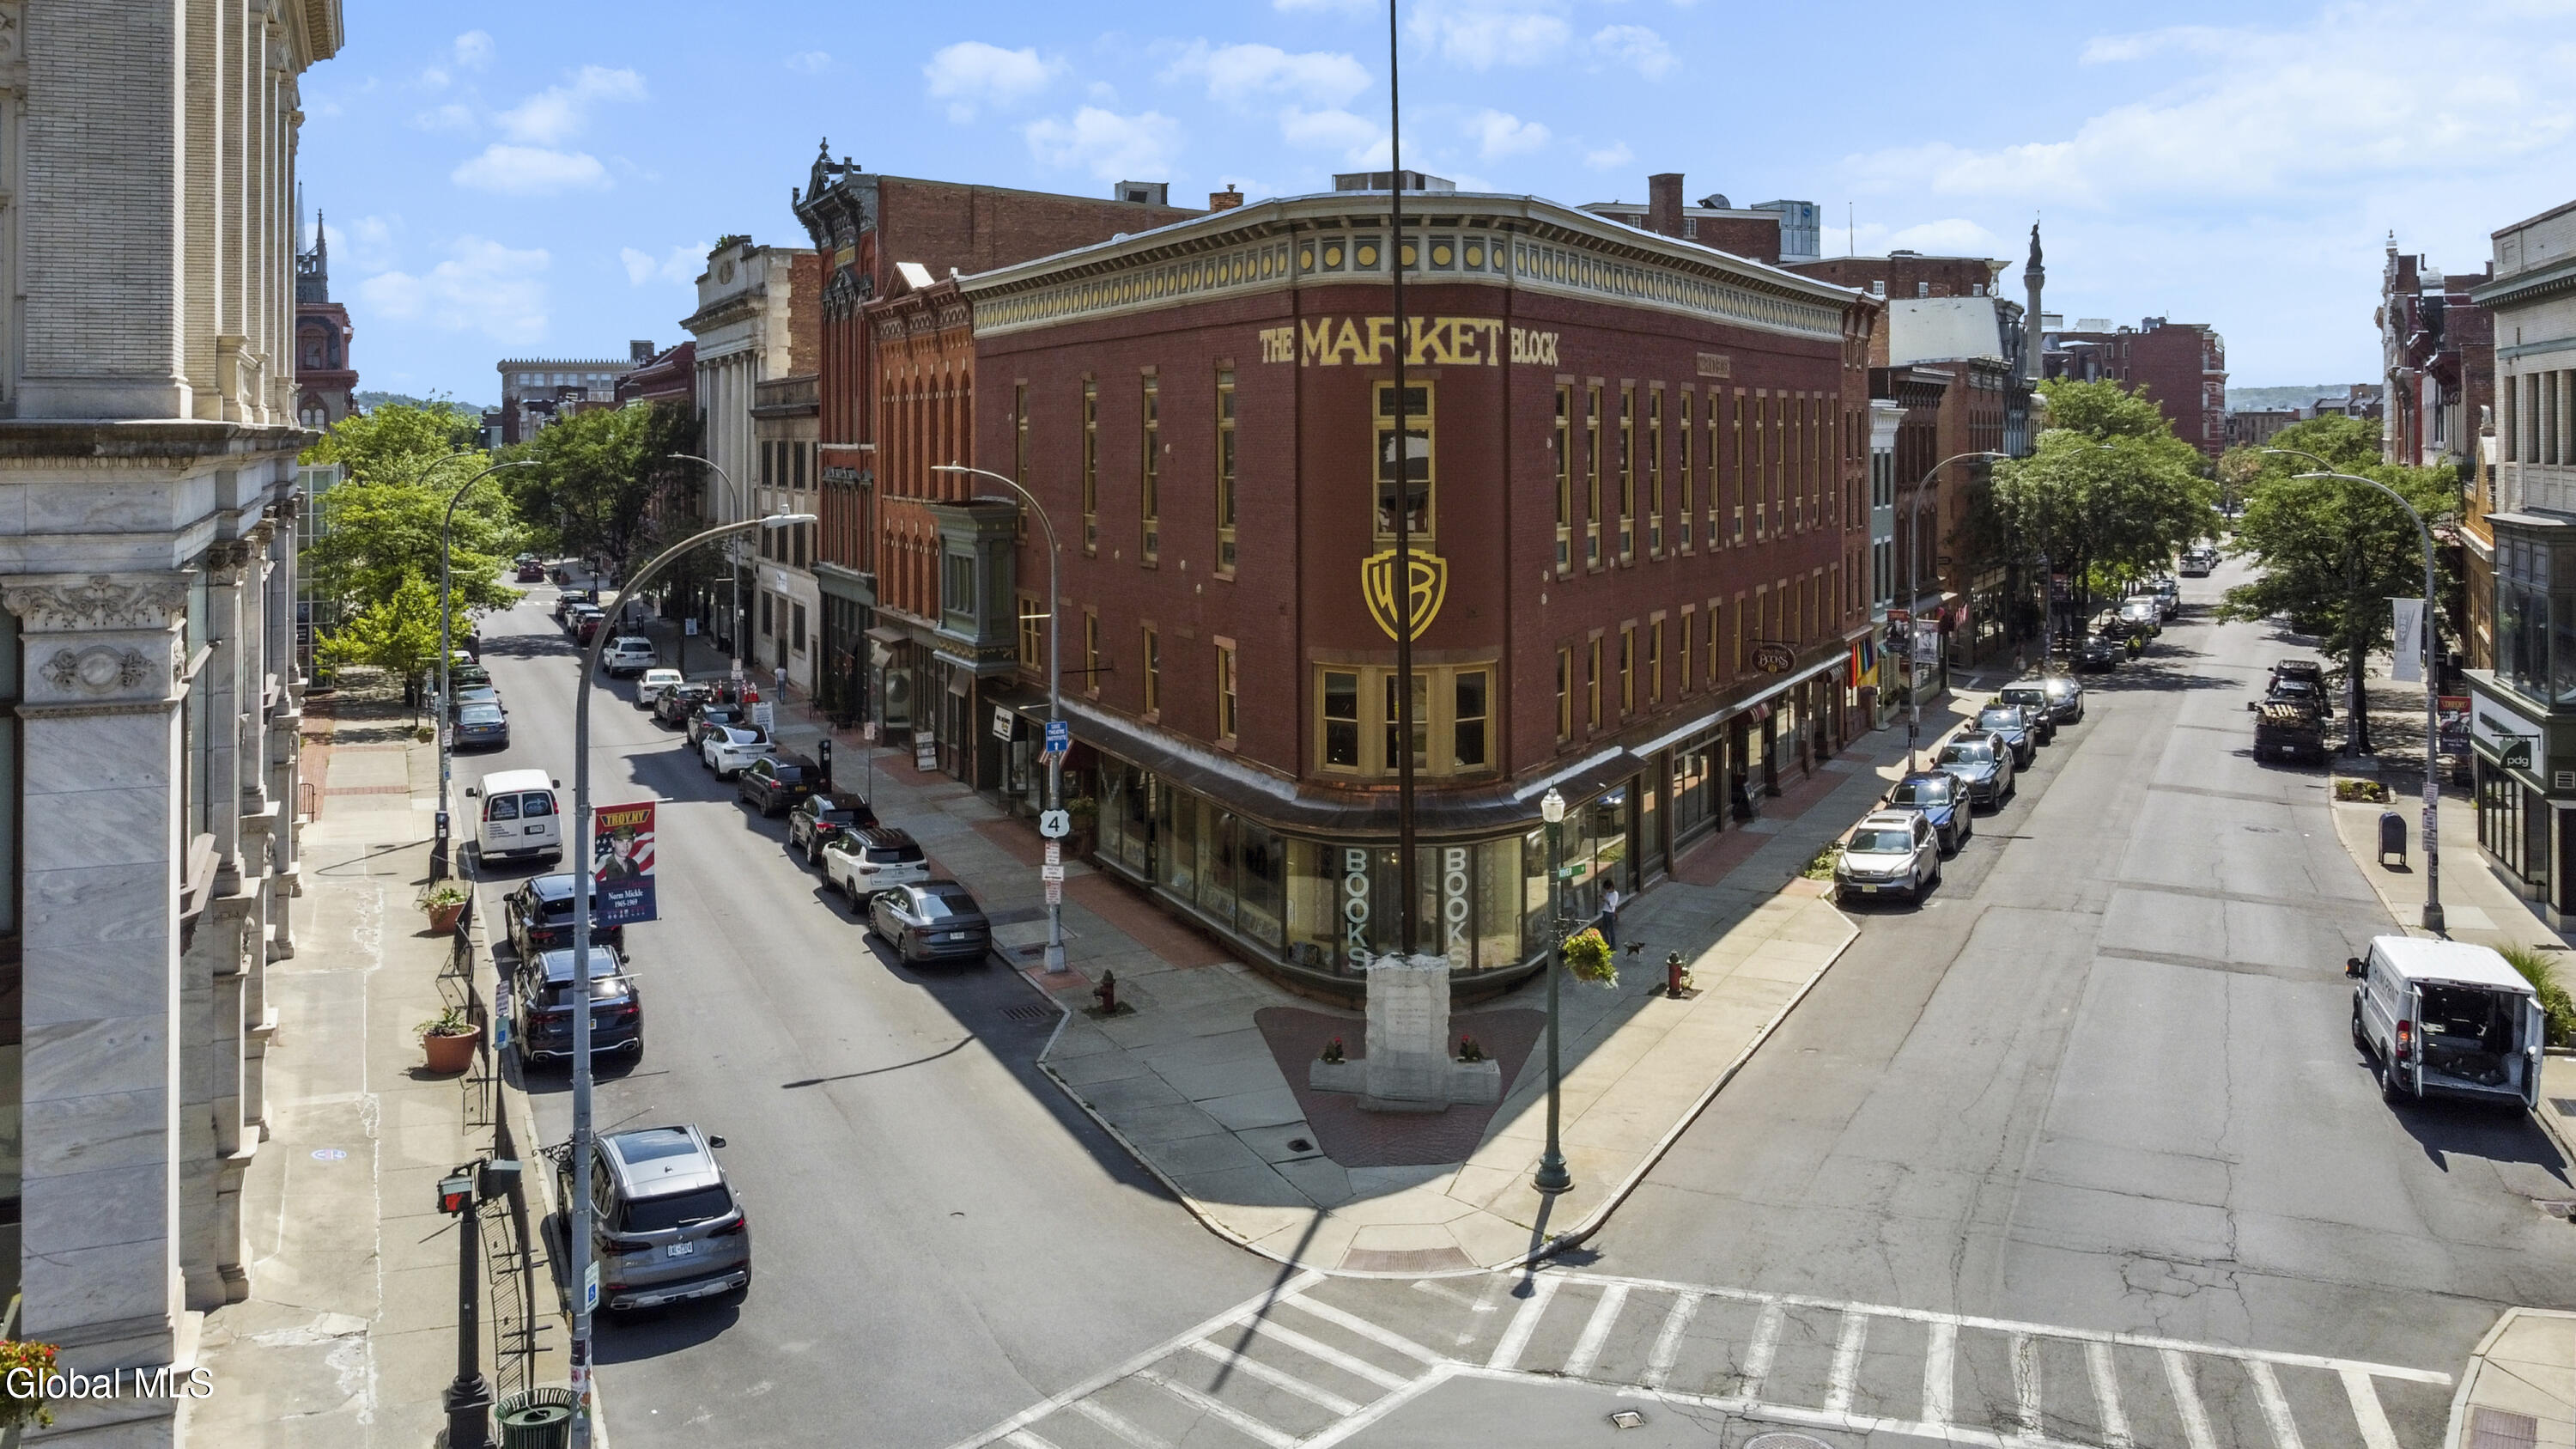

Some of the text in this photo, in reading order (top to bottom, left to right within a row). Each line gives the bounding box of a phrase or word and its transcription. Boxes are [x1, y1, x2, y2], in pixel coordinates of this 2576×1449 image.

[1260, 316, 1559, 367] THE MARKET BLOCK
[2506, 756, 2529, 767] pdg
[1048, 816, 1060, 832] 4
[1345, 848, 1370, 971] BOOKS
[1443, 847, 1469, 970] BOOKS
